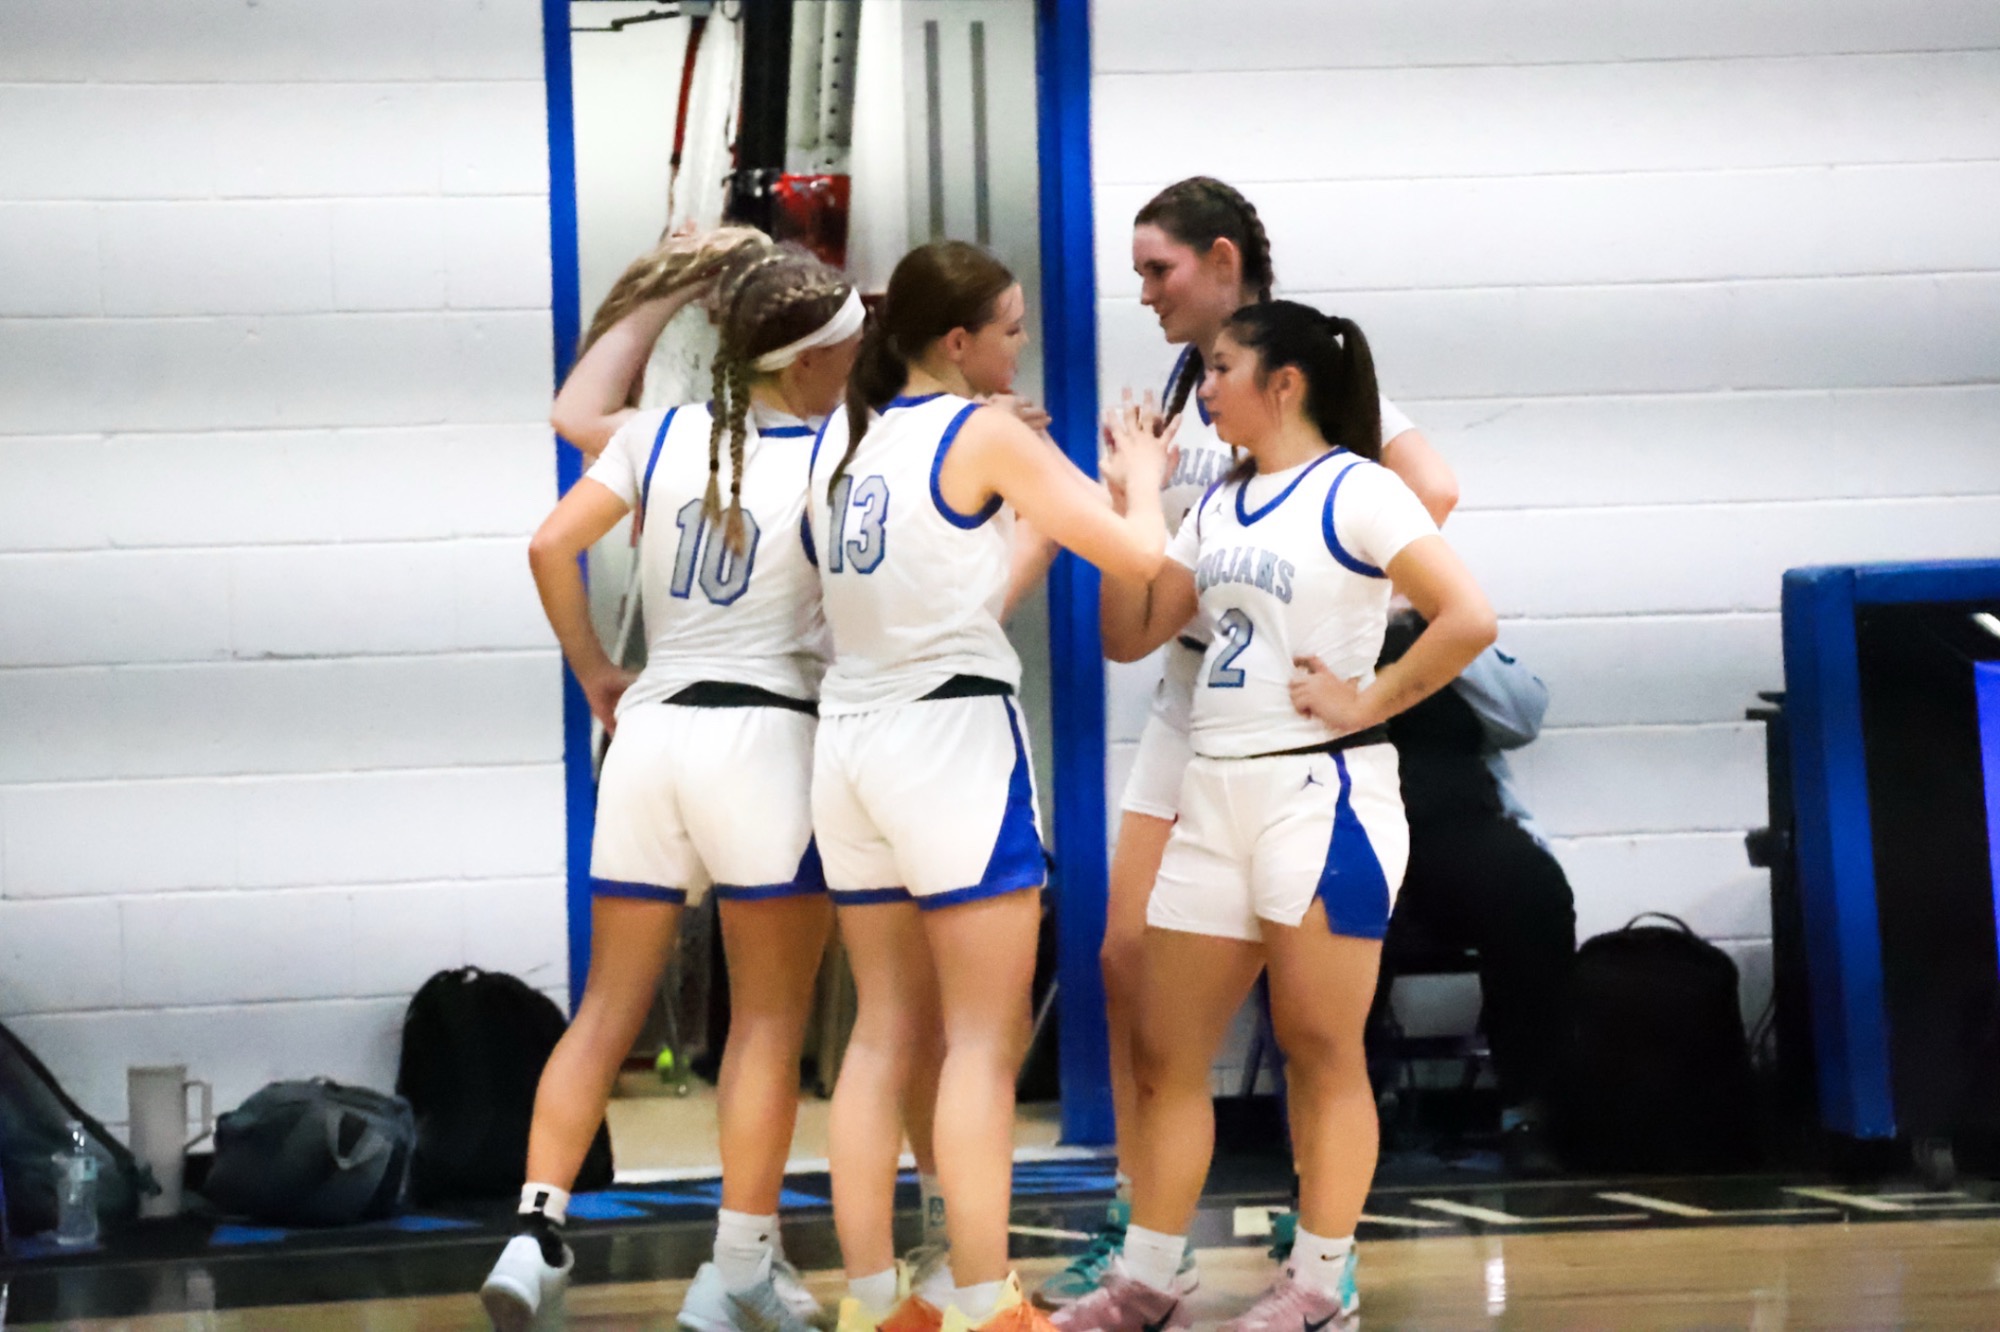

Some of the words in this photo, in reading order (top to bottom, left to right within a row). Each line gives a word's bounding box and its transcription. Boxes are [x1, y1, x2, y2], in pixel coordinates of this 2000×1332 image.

[670, 498, 760, 606] 10
[828, 474, 889, 573] 13
[1207, 607, 1254, 688] 2
